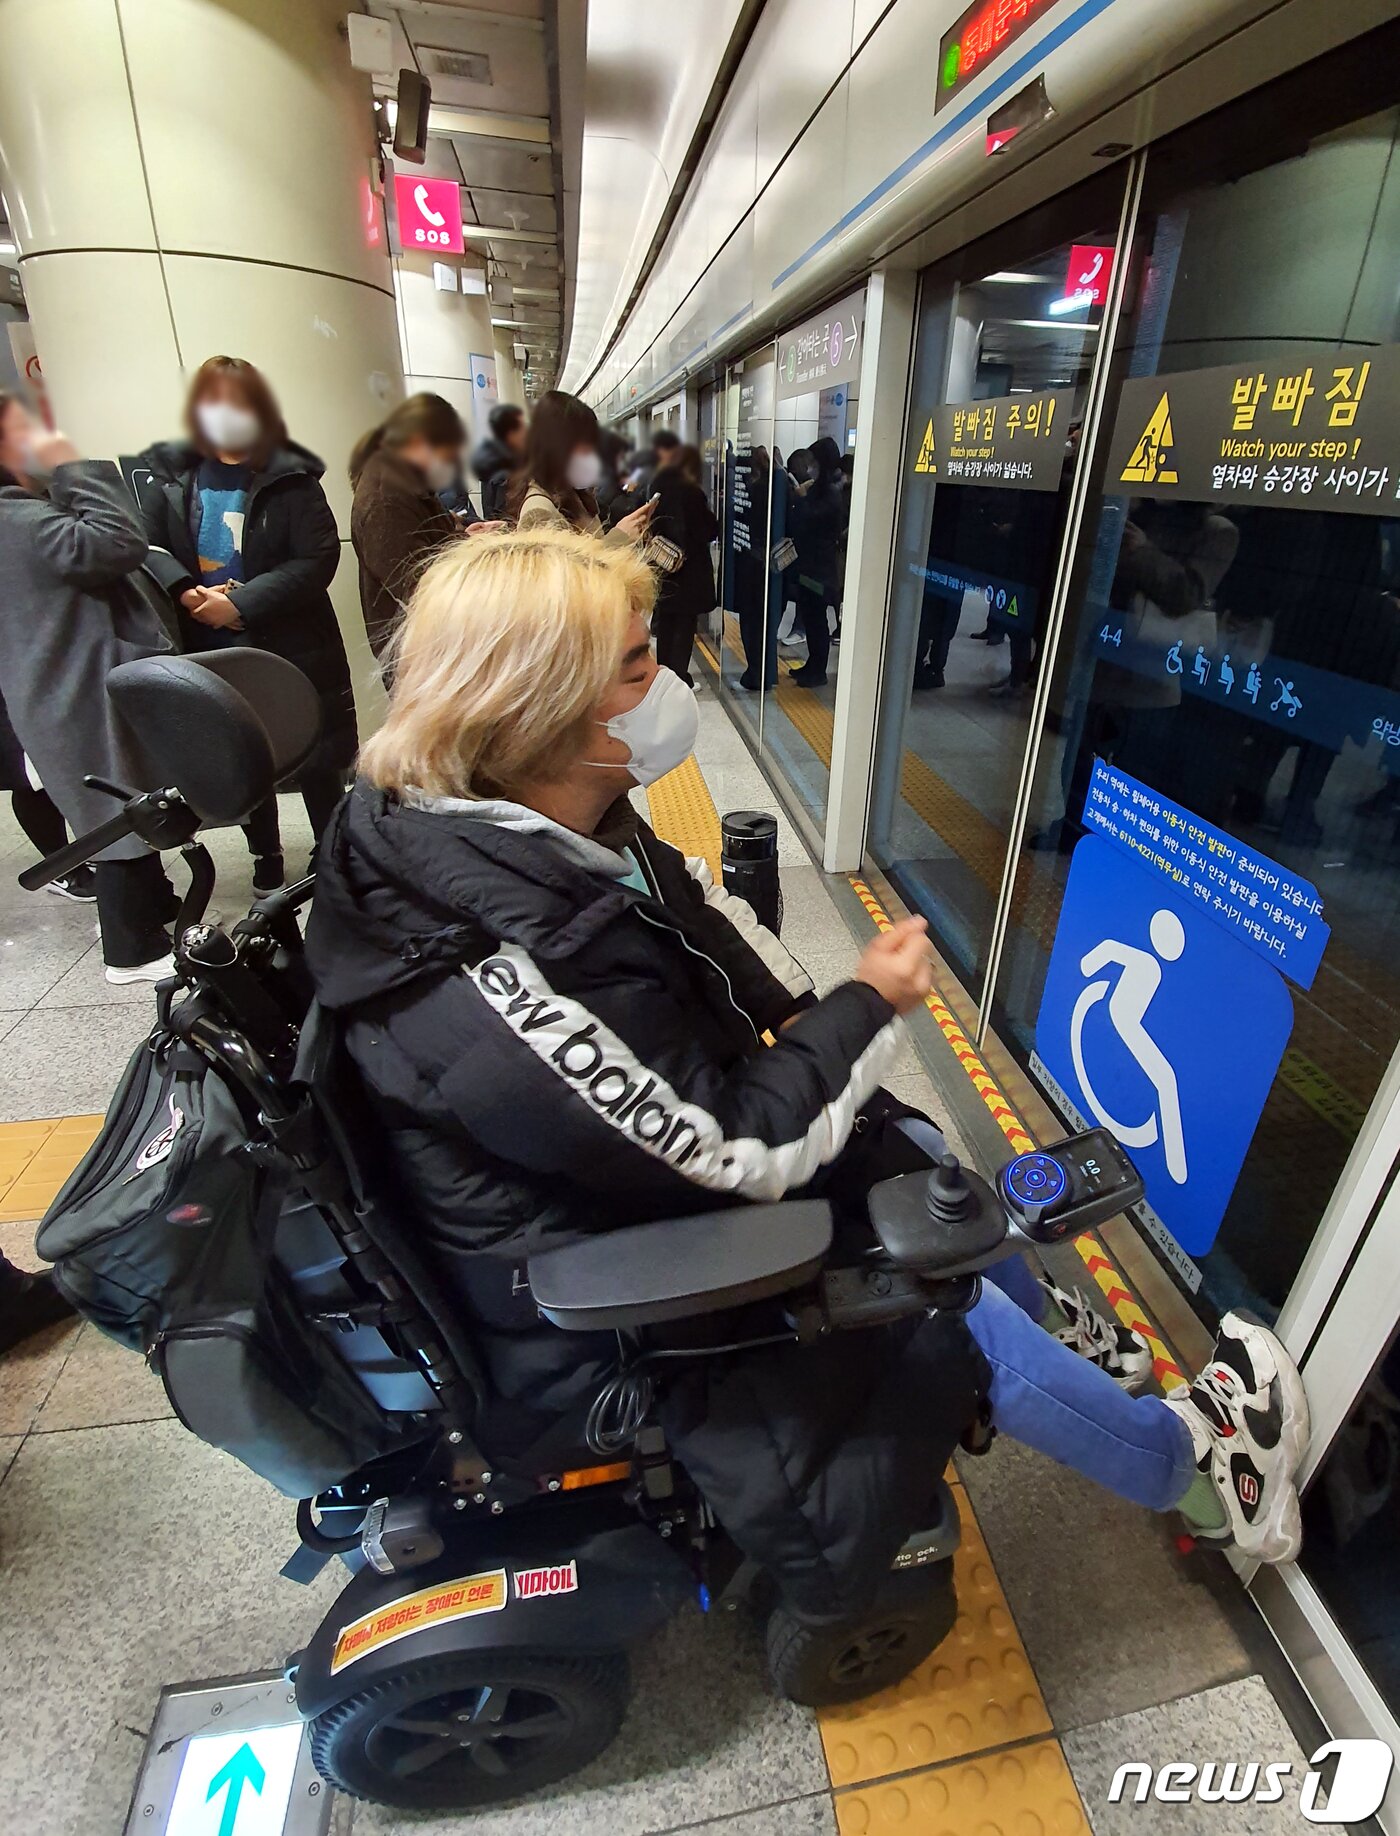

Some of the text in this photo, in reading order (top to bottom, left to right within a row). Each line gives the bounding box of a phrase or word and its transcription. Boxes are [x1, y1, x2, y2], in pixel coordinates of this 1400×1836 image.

[415, 228, 450, 245] SOS
[1231, 361, 1371, 431] 발빠짐
[953, 398, 1056, 442] 발빠짐 주의!
[964, 460, 982, 478] 승강장
[982, 461, 1003, 478] 사이가
[1003, 461, 1033, 479] 넓습니다.
[1220, 438, 1264, 459] Watch
[1268, 443, 1307, 462] your
[1211, 464, 1259, 490] 열차와
[1262, 465, 1320, 494] 승강장
[1323, 466, 1389, 497] 사이가
[1100, 624, 1123, 648] 4-4
[1096, 768, 1110, 785] 우리
[1110, 776, 1131, 798] 역에는
[1131, 789, 1161, 817] 휠체어용
[1162, 809, 1188, 834] 이동식
[1188, 825, 1207, 846] 안전
[1208, 836, 1237, 864] 발판이
[1237, 855, 1280, 892] 준비되어
[1086, 807, 1119, 837] 고객께서는
[1193, 881, 1212, 903] 연락
[1212, 895, 1242, 925] 주시기
[1242, 917, 1287, 959] 바랍니다.
[1092, 787, 1111, 808] 전동차
[1139, 818, 1161, 842] 편의를
[1162, 834, 1180, 854] 위한
[1180, 847, 1207, 873] 이동식
[1208, 864, 1228, 887] 안전
[1229, 877, 1260, 908] 발판을
[1262, 902, 1308, 941] 이용하실
[1086, 1159, 1101, 1175] 0.0
[1159, 1229, 1195, 1284] 있습니다.
[375, 1605, 422, 1635] 저항하는
[424, 1589, 466, 1615] 장애인
[467, 1583, 494, 1603] 언론
